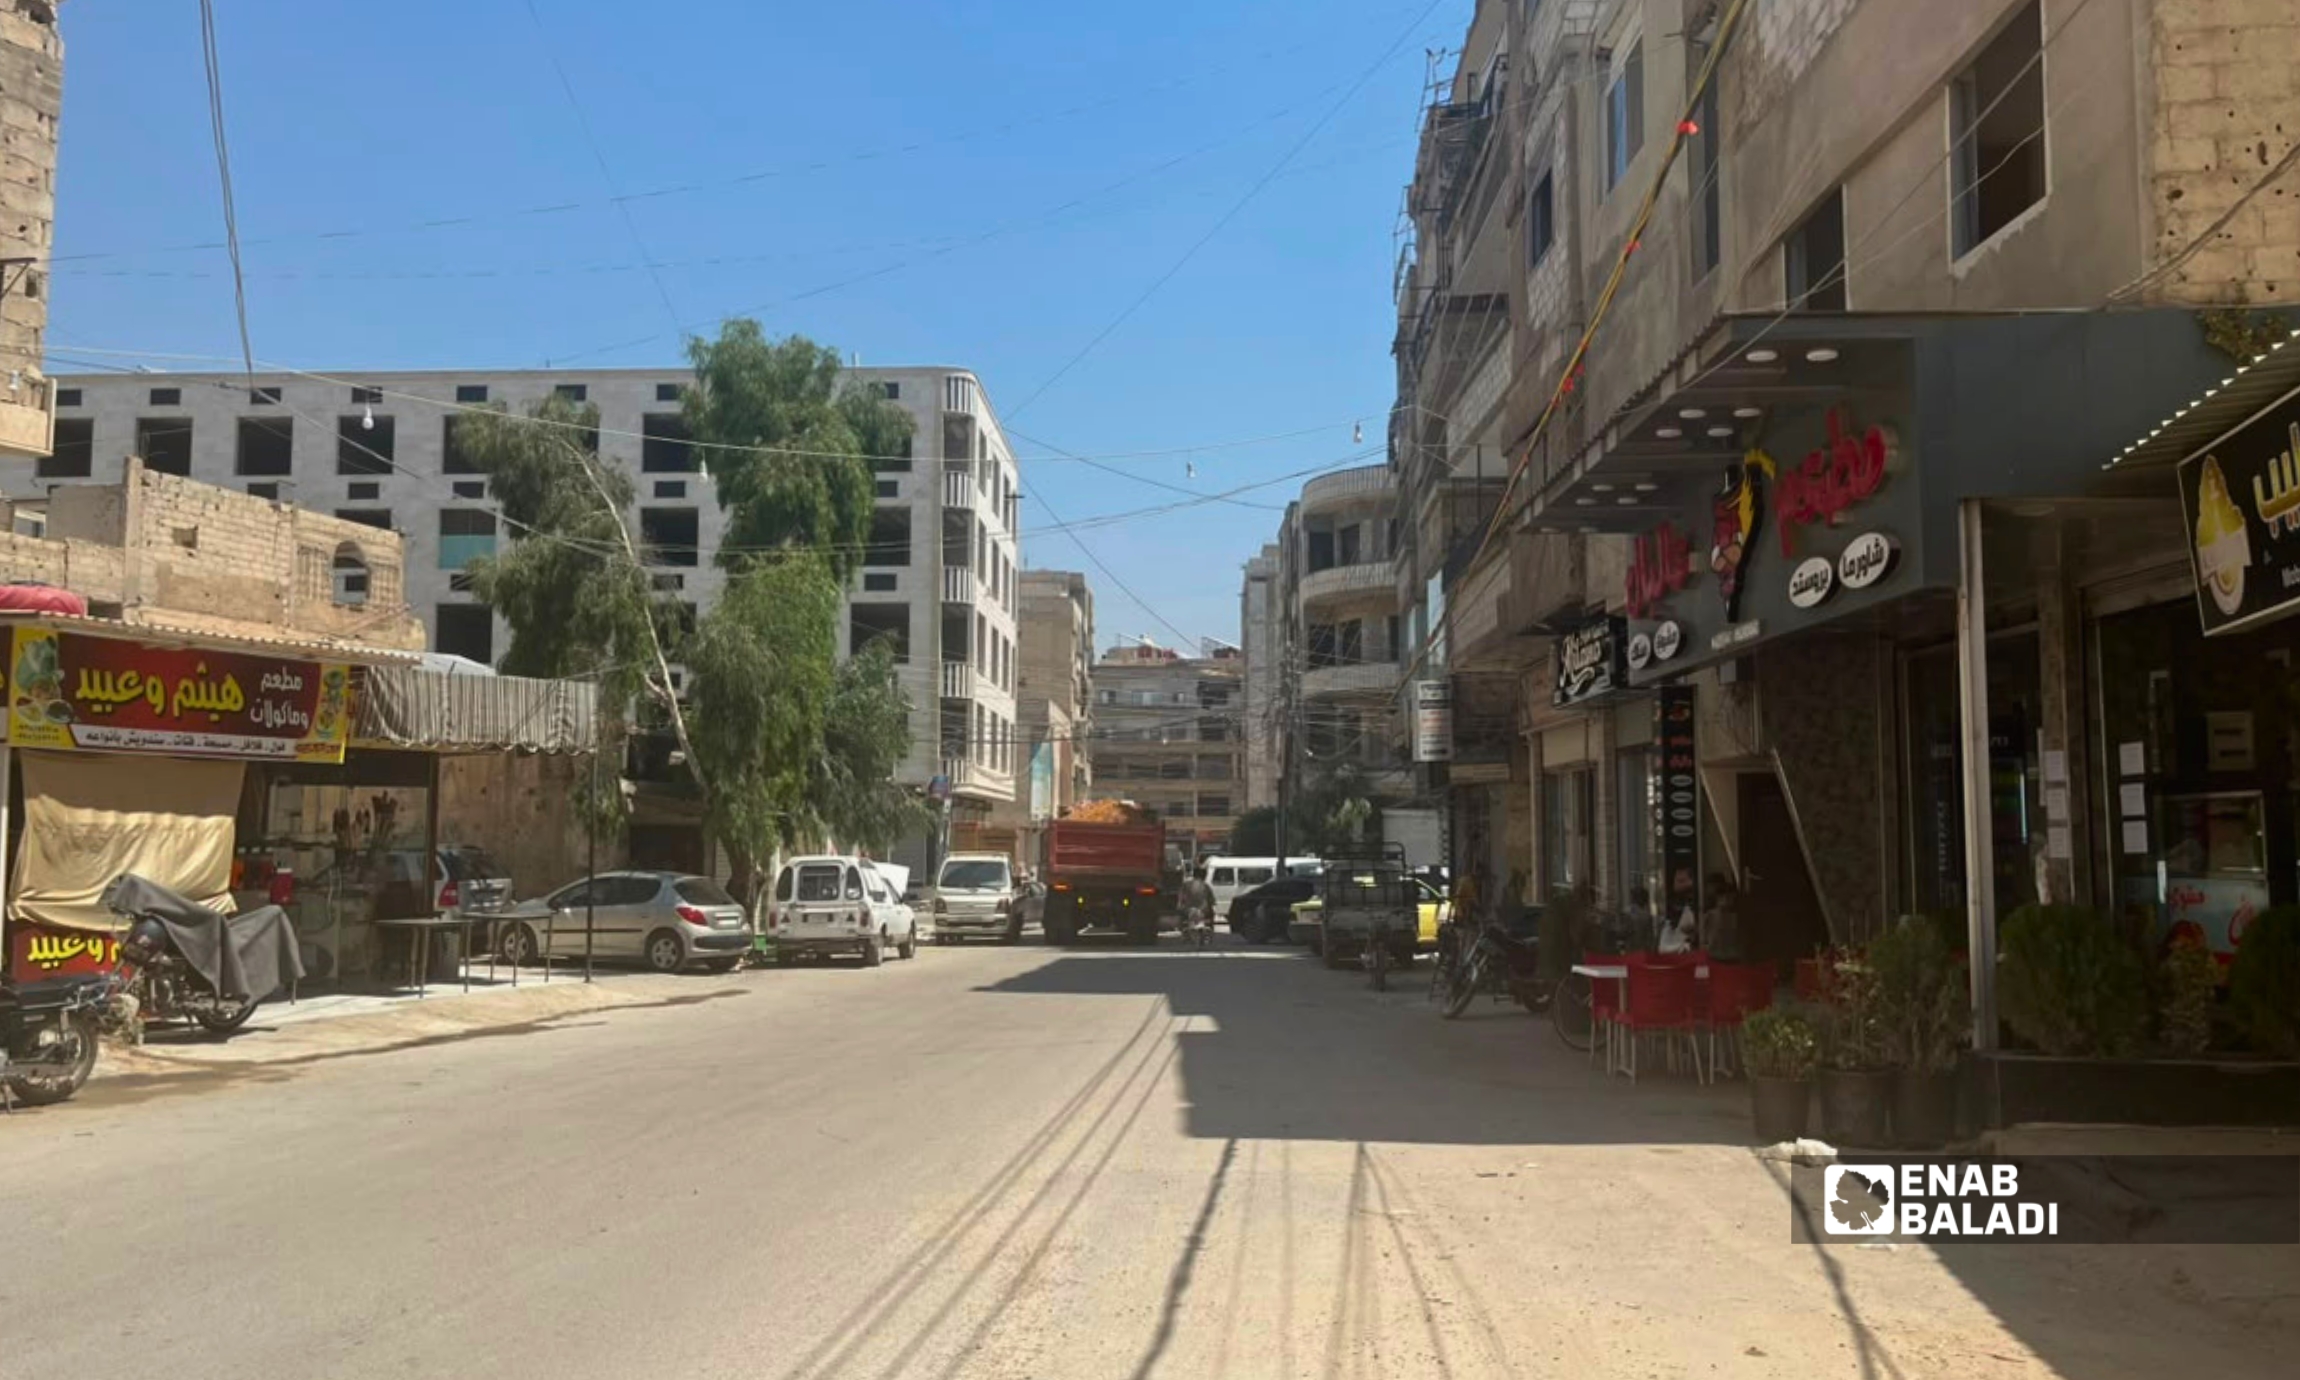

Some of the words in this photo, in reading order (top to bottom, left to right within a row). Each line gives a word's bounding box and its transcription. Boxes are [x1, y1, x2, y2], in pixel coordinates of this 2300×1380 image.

[1843, 537, 1884, 580] شاورما
[75, 667, 165, 713] وعبيد
[172, 660, 245, 721] هيثم
[261, 665, 304, 693] مطعم
[27, 934, 104, 970] وعبيد
